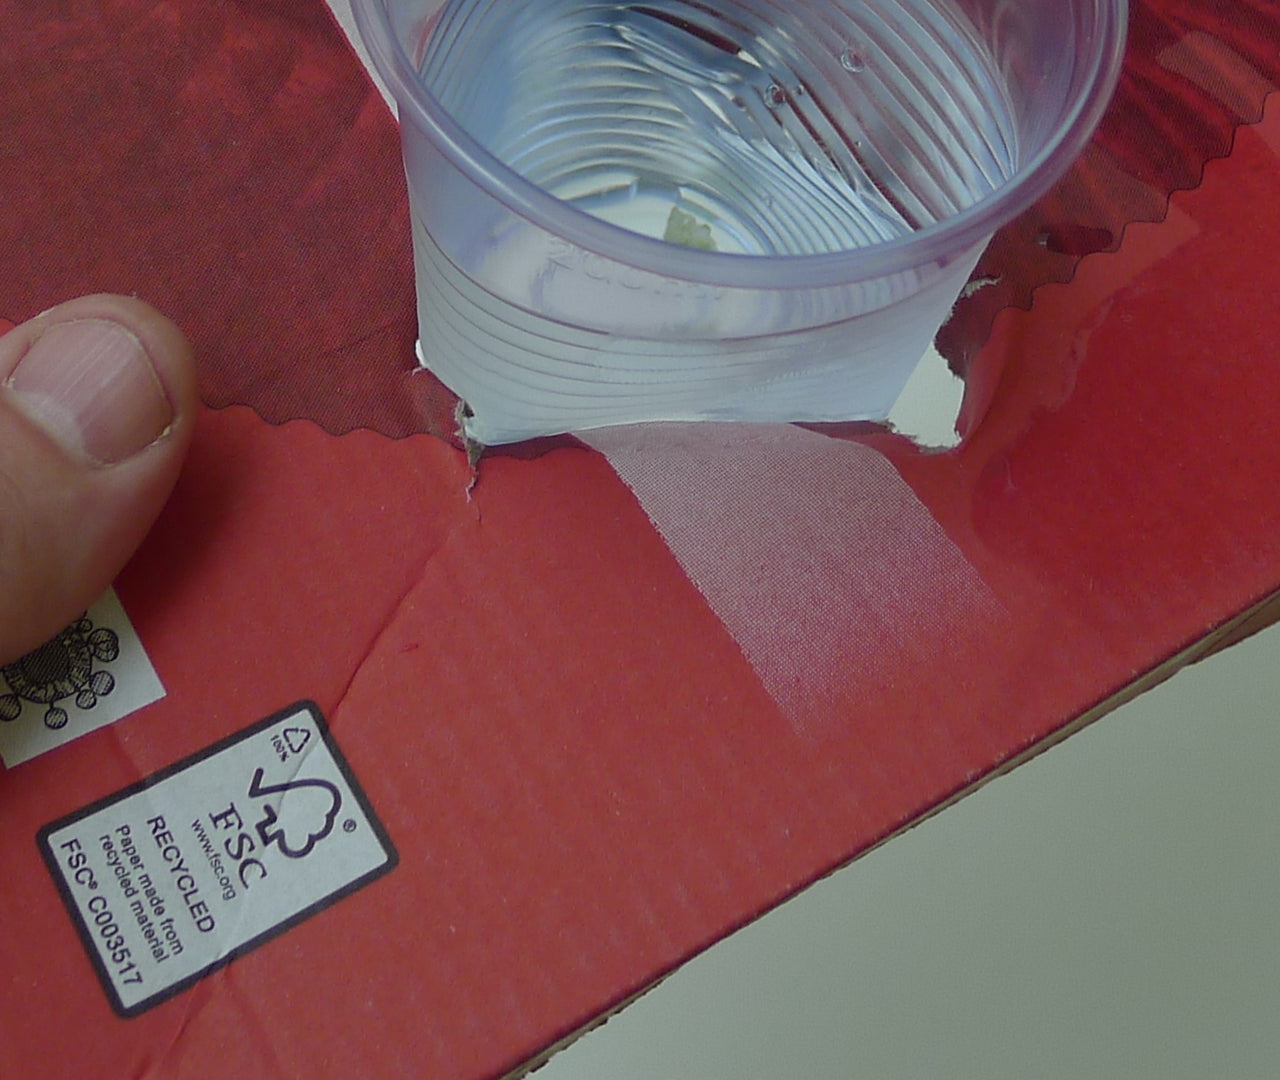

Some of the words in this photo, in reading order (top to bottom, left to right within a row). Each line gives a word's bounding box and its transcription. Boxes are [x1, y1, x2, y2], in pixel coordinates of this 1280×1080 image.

[95, 833, 138, 899] recycled
[128, 898, 170, 964] material
[111, 824, 146, 872] Paper
[136, 872, 167, 917] made
[158, 917, 186, 956] from
[145, 813, 217, 935] RECYCLED
[187, 817, 238, 901] www.fsc.org
[208, 802, 269, 889] FSC
[84, 893, 144, 990] C003517
